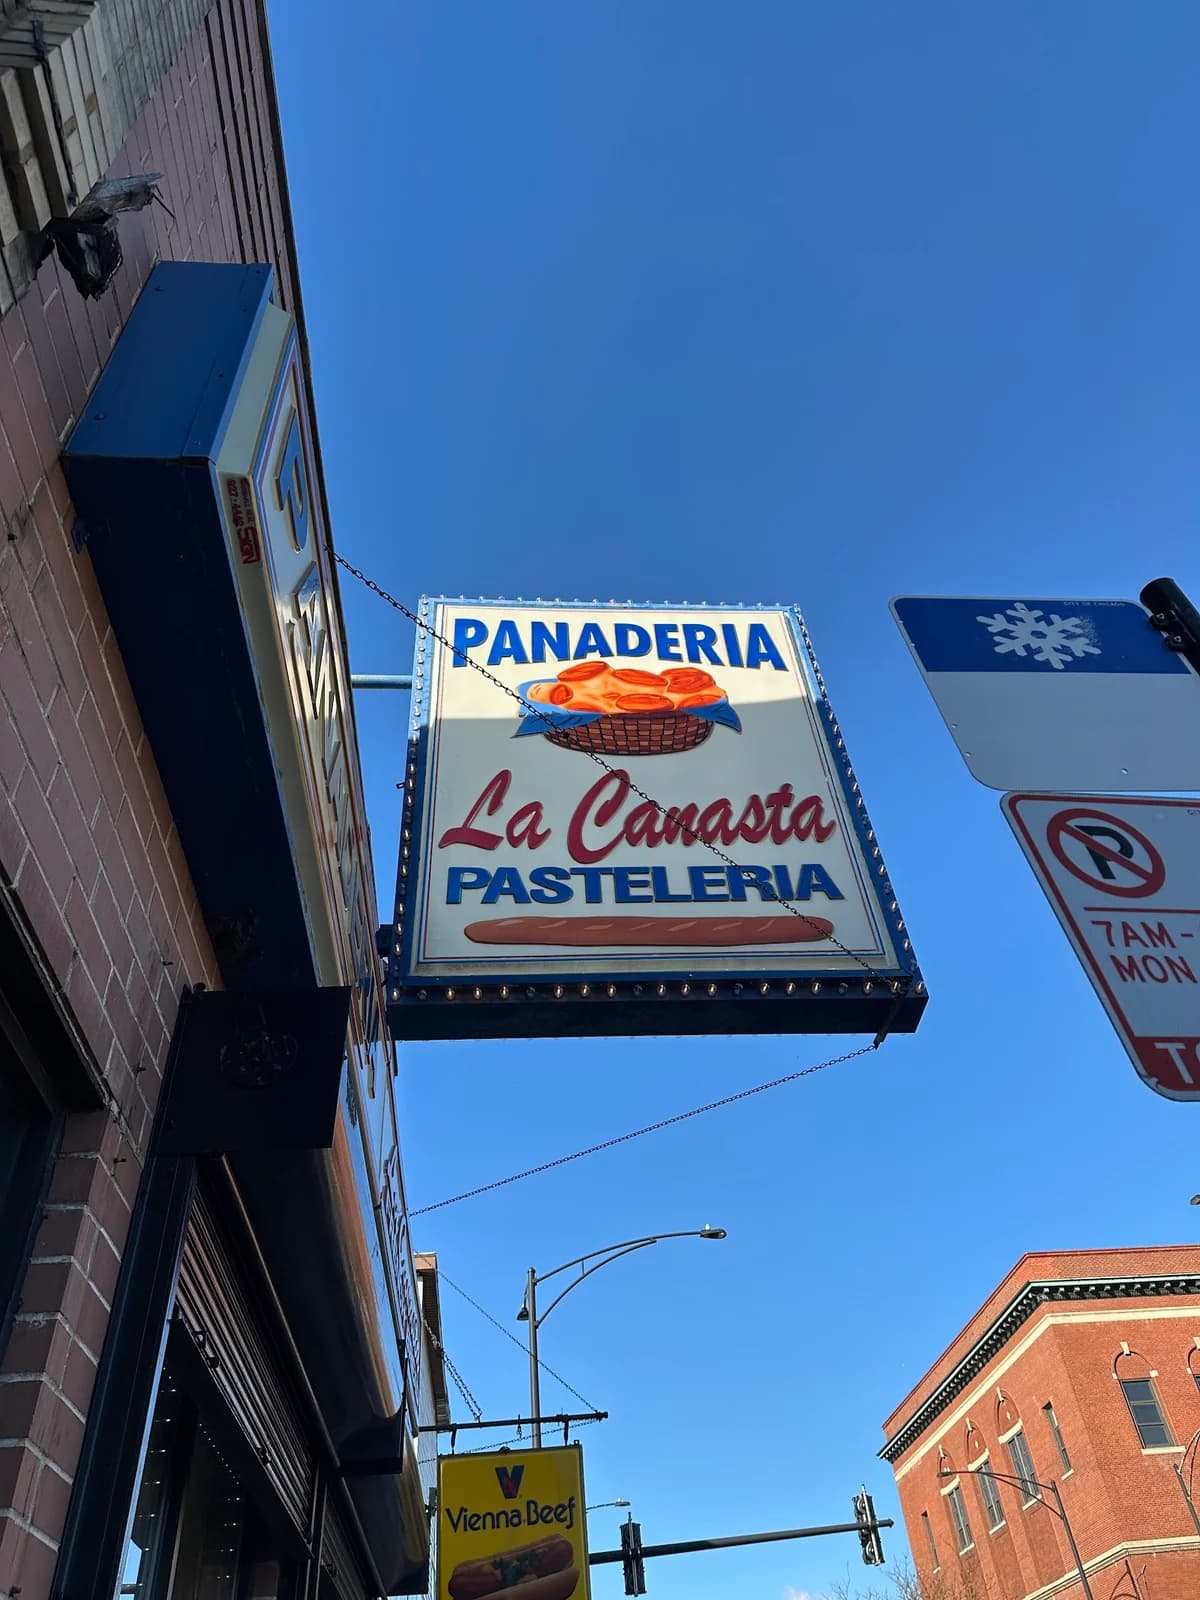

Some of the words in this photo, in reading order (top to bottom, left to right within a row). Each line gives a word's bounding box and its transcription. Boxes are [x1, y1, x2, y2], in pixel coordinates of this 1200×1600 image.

[452, 617, 790, 673] PANADERIA
[438, 768, 552, 851] La
[566, 768, 838, 865] Canasta
[445, 862, 846, 906] PASTELERIA
[1109, 954, 1198, 984] MON
[1154, 1041, 1200, 1085] T
[445, 1506, 522, 1533] Vienna
[526, 1496, 576, 1530] Beef
